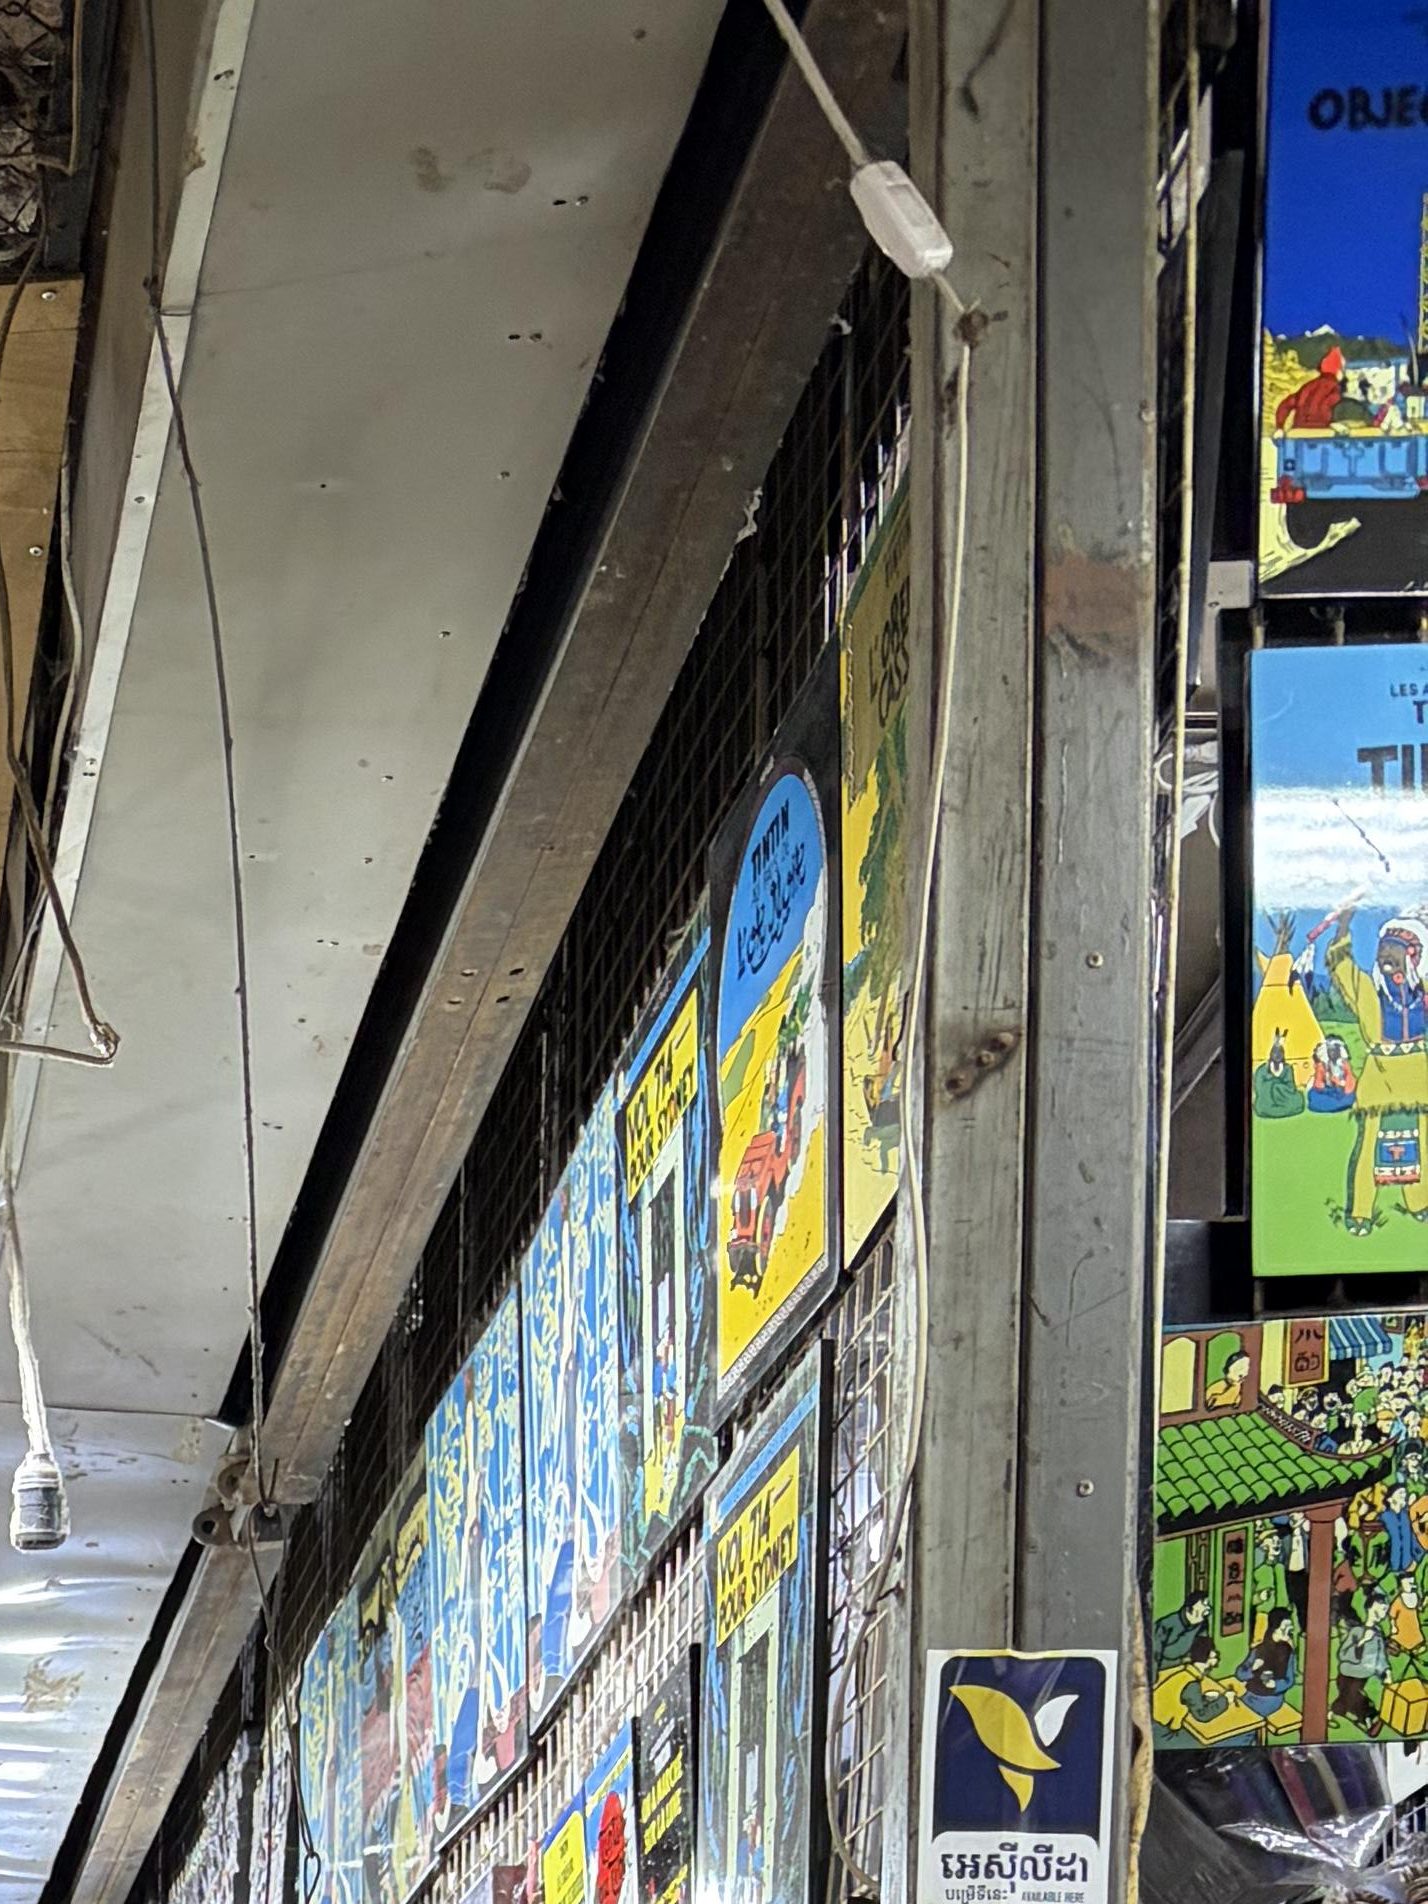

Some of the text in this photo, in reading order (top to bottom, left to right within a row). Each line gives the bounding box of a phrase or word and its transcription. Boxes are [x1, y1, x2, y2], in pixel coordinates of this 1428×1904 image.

[1308, 85, 1428, 132] OBJE
[1389, 683, 1419, 697] LES
[751, 800, 791, 884] TINTIN
[626, 1084, 651, 1148] VOL
[720, 1487, 774, 1595] VOL 714
[718, 1518, 795, 1643] POUR SYDNEY
[1022, 1891, 1085, 1904] AVAILABLE HERE
